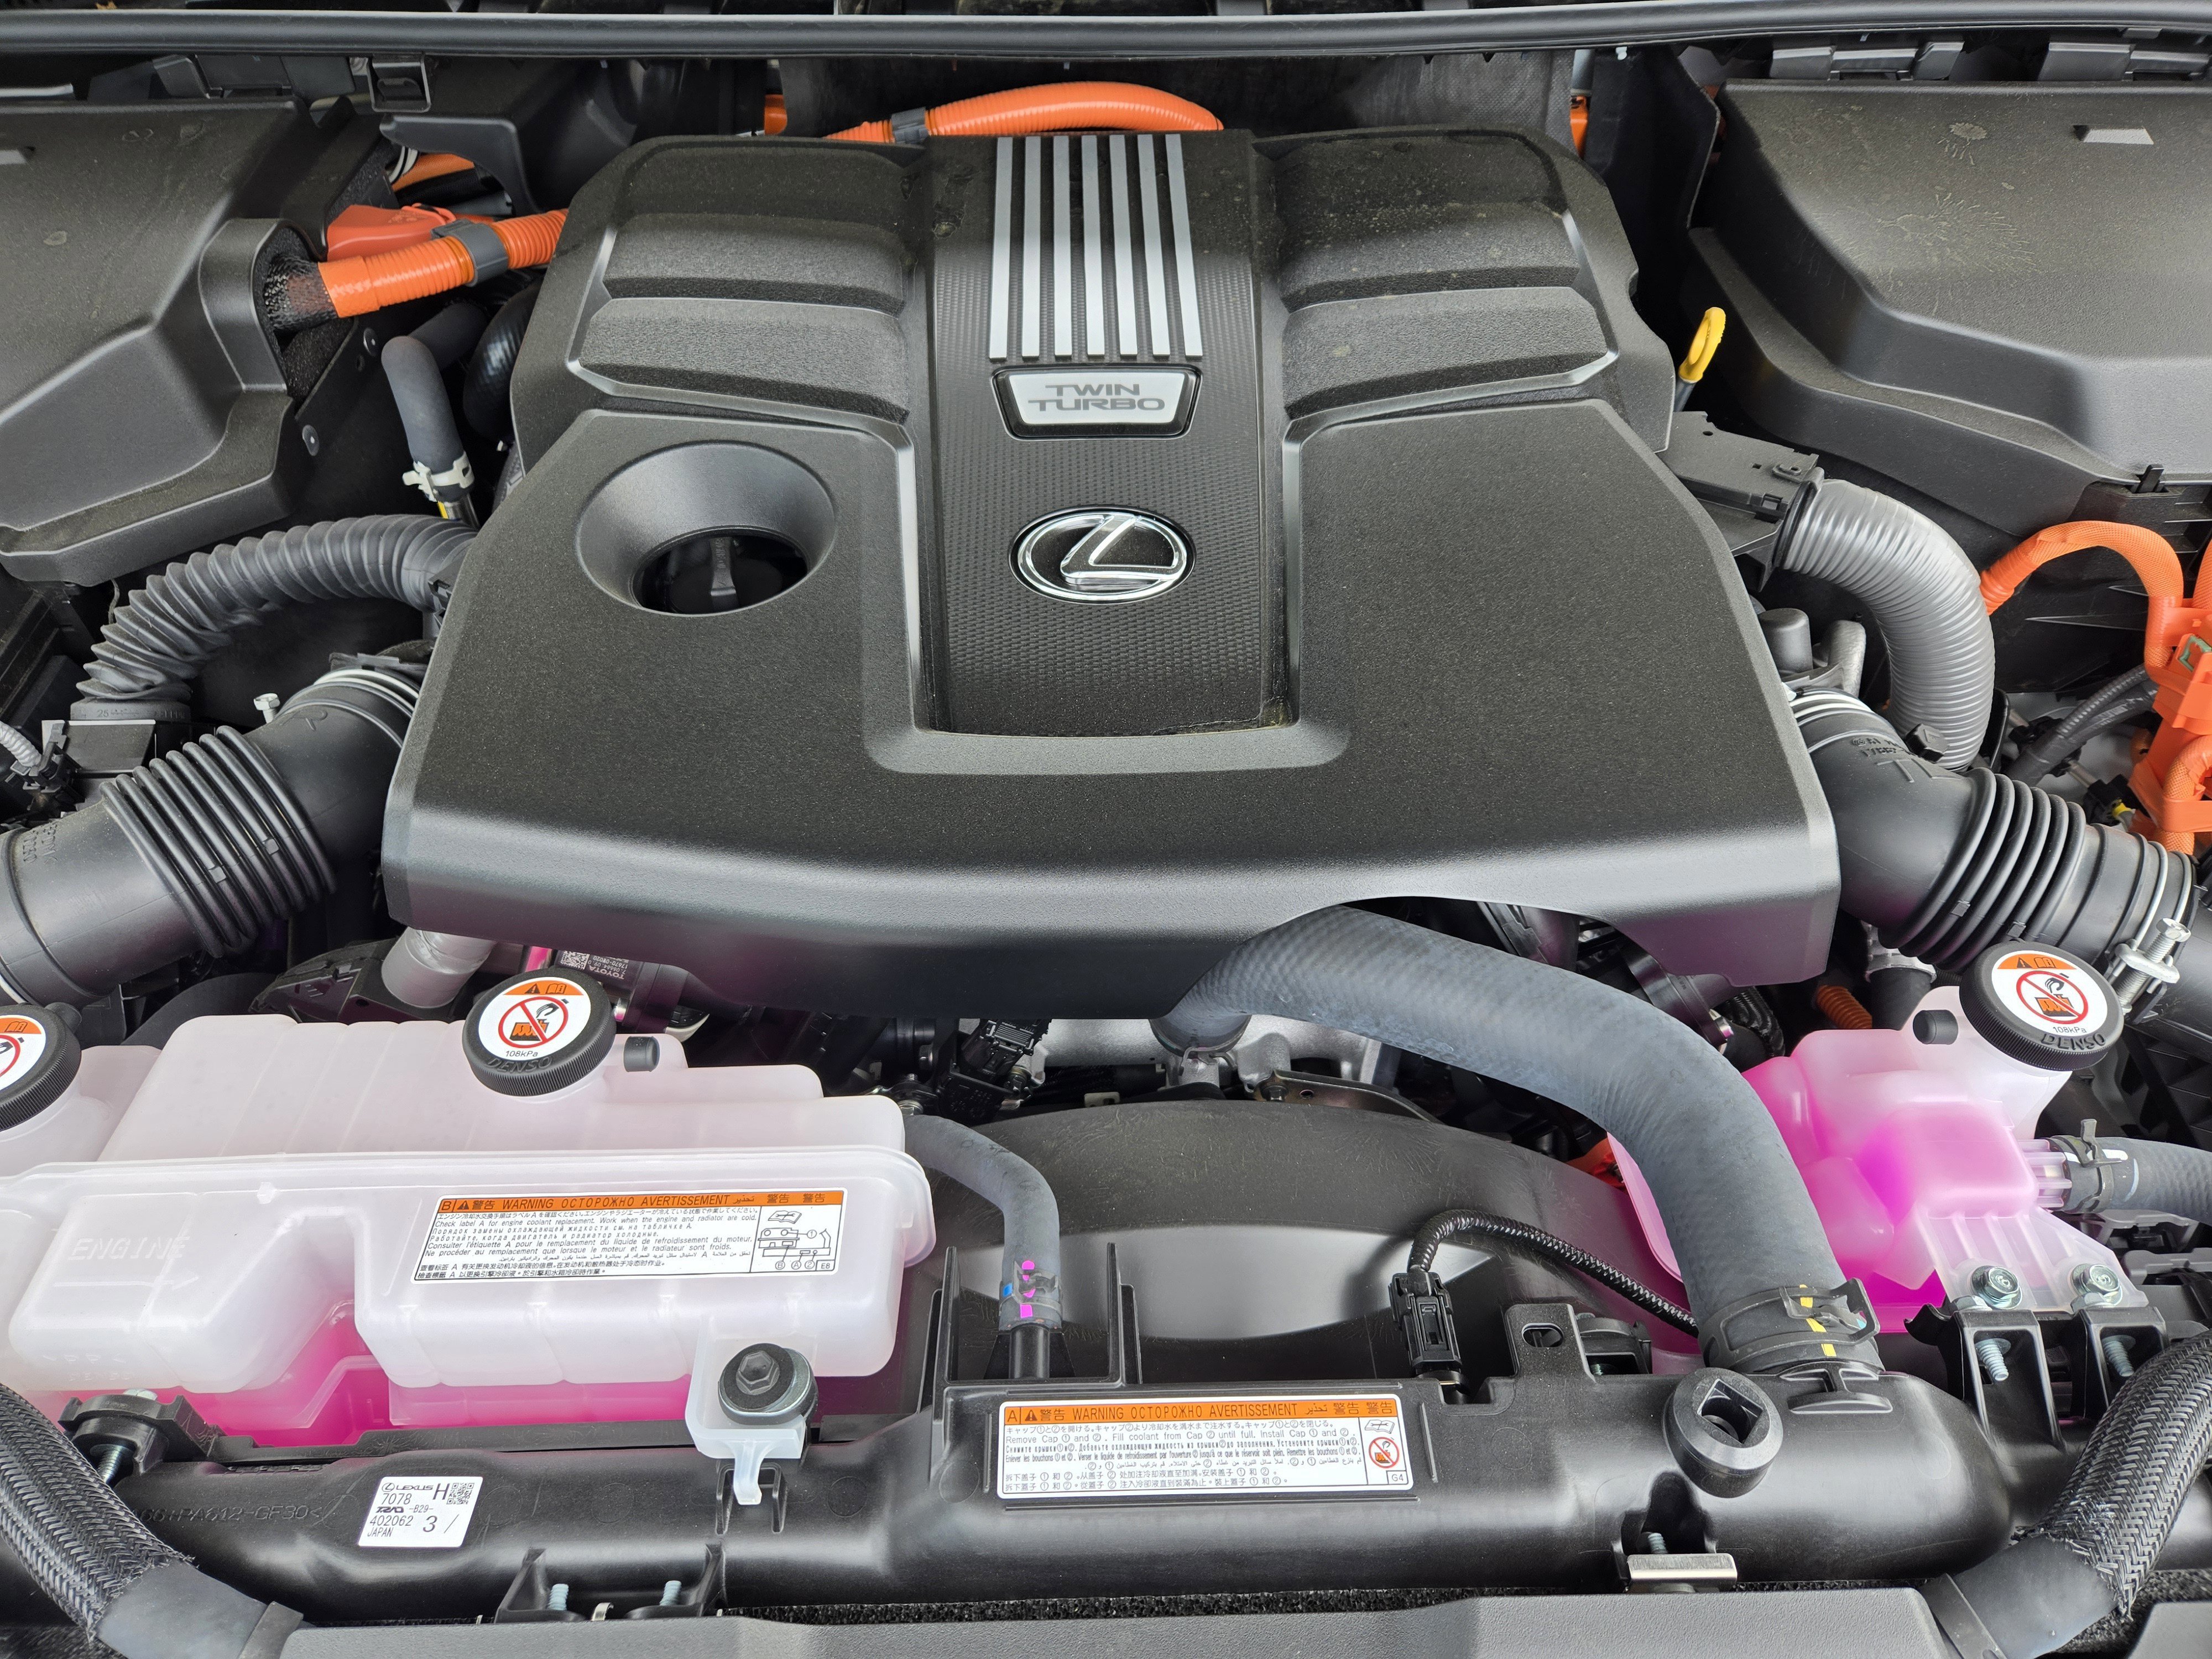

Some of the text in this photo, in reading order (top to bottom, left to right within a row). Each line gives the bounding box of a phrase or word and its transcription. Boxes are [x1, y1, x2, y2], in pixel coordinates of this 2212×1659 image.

[1045, 384, 1140, 397] TWIN
[1028, 398, 1165, 411] TURBO
[589, 964, 624, 980] TOYOTA
[2041, 1032, 2106, 1051] DENSO
[486, 1057, 552, 1072] DENSO
[441, 1201, 453, 1211] B
[469, 1199, 497, 1211] 警告
[500, 1198, 555, 1210] WARNING
[560, 1197, 635, 1208] ОСТОРОЖНО
[640, 1194, 731, 1207] AVERTISSEMENT
[766, 1193, 790, 1204] 警告
[802, 1192, 826, 1203] 警告
[655, 1215, 678, 1224] engine
[68, 1236, 191, 1260] ENGINE
[426, 1241, 463, 1250] Consulter
[546, 1239, 596, 1247] remplacement
[654, 1236, 709, 1244] refroidissement
[1007, 1409, 1018, 1422] A
[1040, 1408, 1065, 1421] 警告
[1072, 1407, 1124, 1420] WARNING
[1131, 1405, 1202, 1419] ОСТОРОЖНО
[1209, 1403, 1298, 1417] AVERTISSEMENT
[1332, 1402, 1359, 1415] 警告
[1366, 1401, 1392, 1414] 警告
[1006, 1436, 1036, 1444] Remove
[1041, 1434, 1058, 1443] Cap
[1074, 1433, 1089, 1442] and
[1129, 1432, 1159, 1441] coolant
[1164, 1431, 1181, 1439] from
[1186, 1431, 1202, 1439] Cap
[1218, 1430, 1235, 1440] until
[1240, 1430, 1255, 1438] full.
[1260, 1430, 1284, 1438] Install
[1288, 1429, 1306, 1438] Cap
[1321, 1428, 1337, 1436] and
[1391, 1473, 1404, 1481] G4
[381, 1493, 413, 1505] 7078
[432, 1483, 451, 1500] H
[369, 1515, 414, 1526] 402062
[422, 1515, 438, 1532] 3
[367, 1527, 394, 1537] JAPAN
